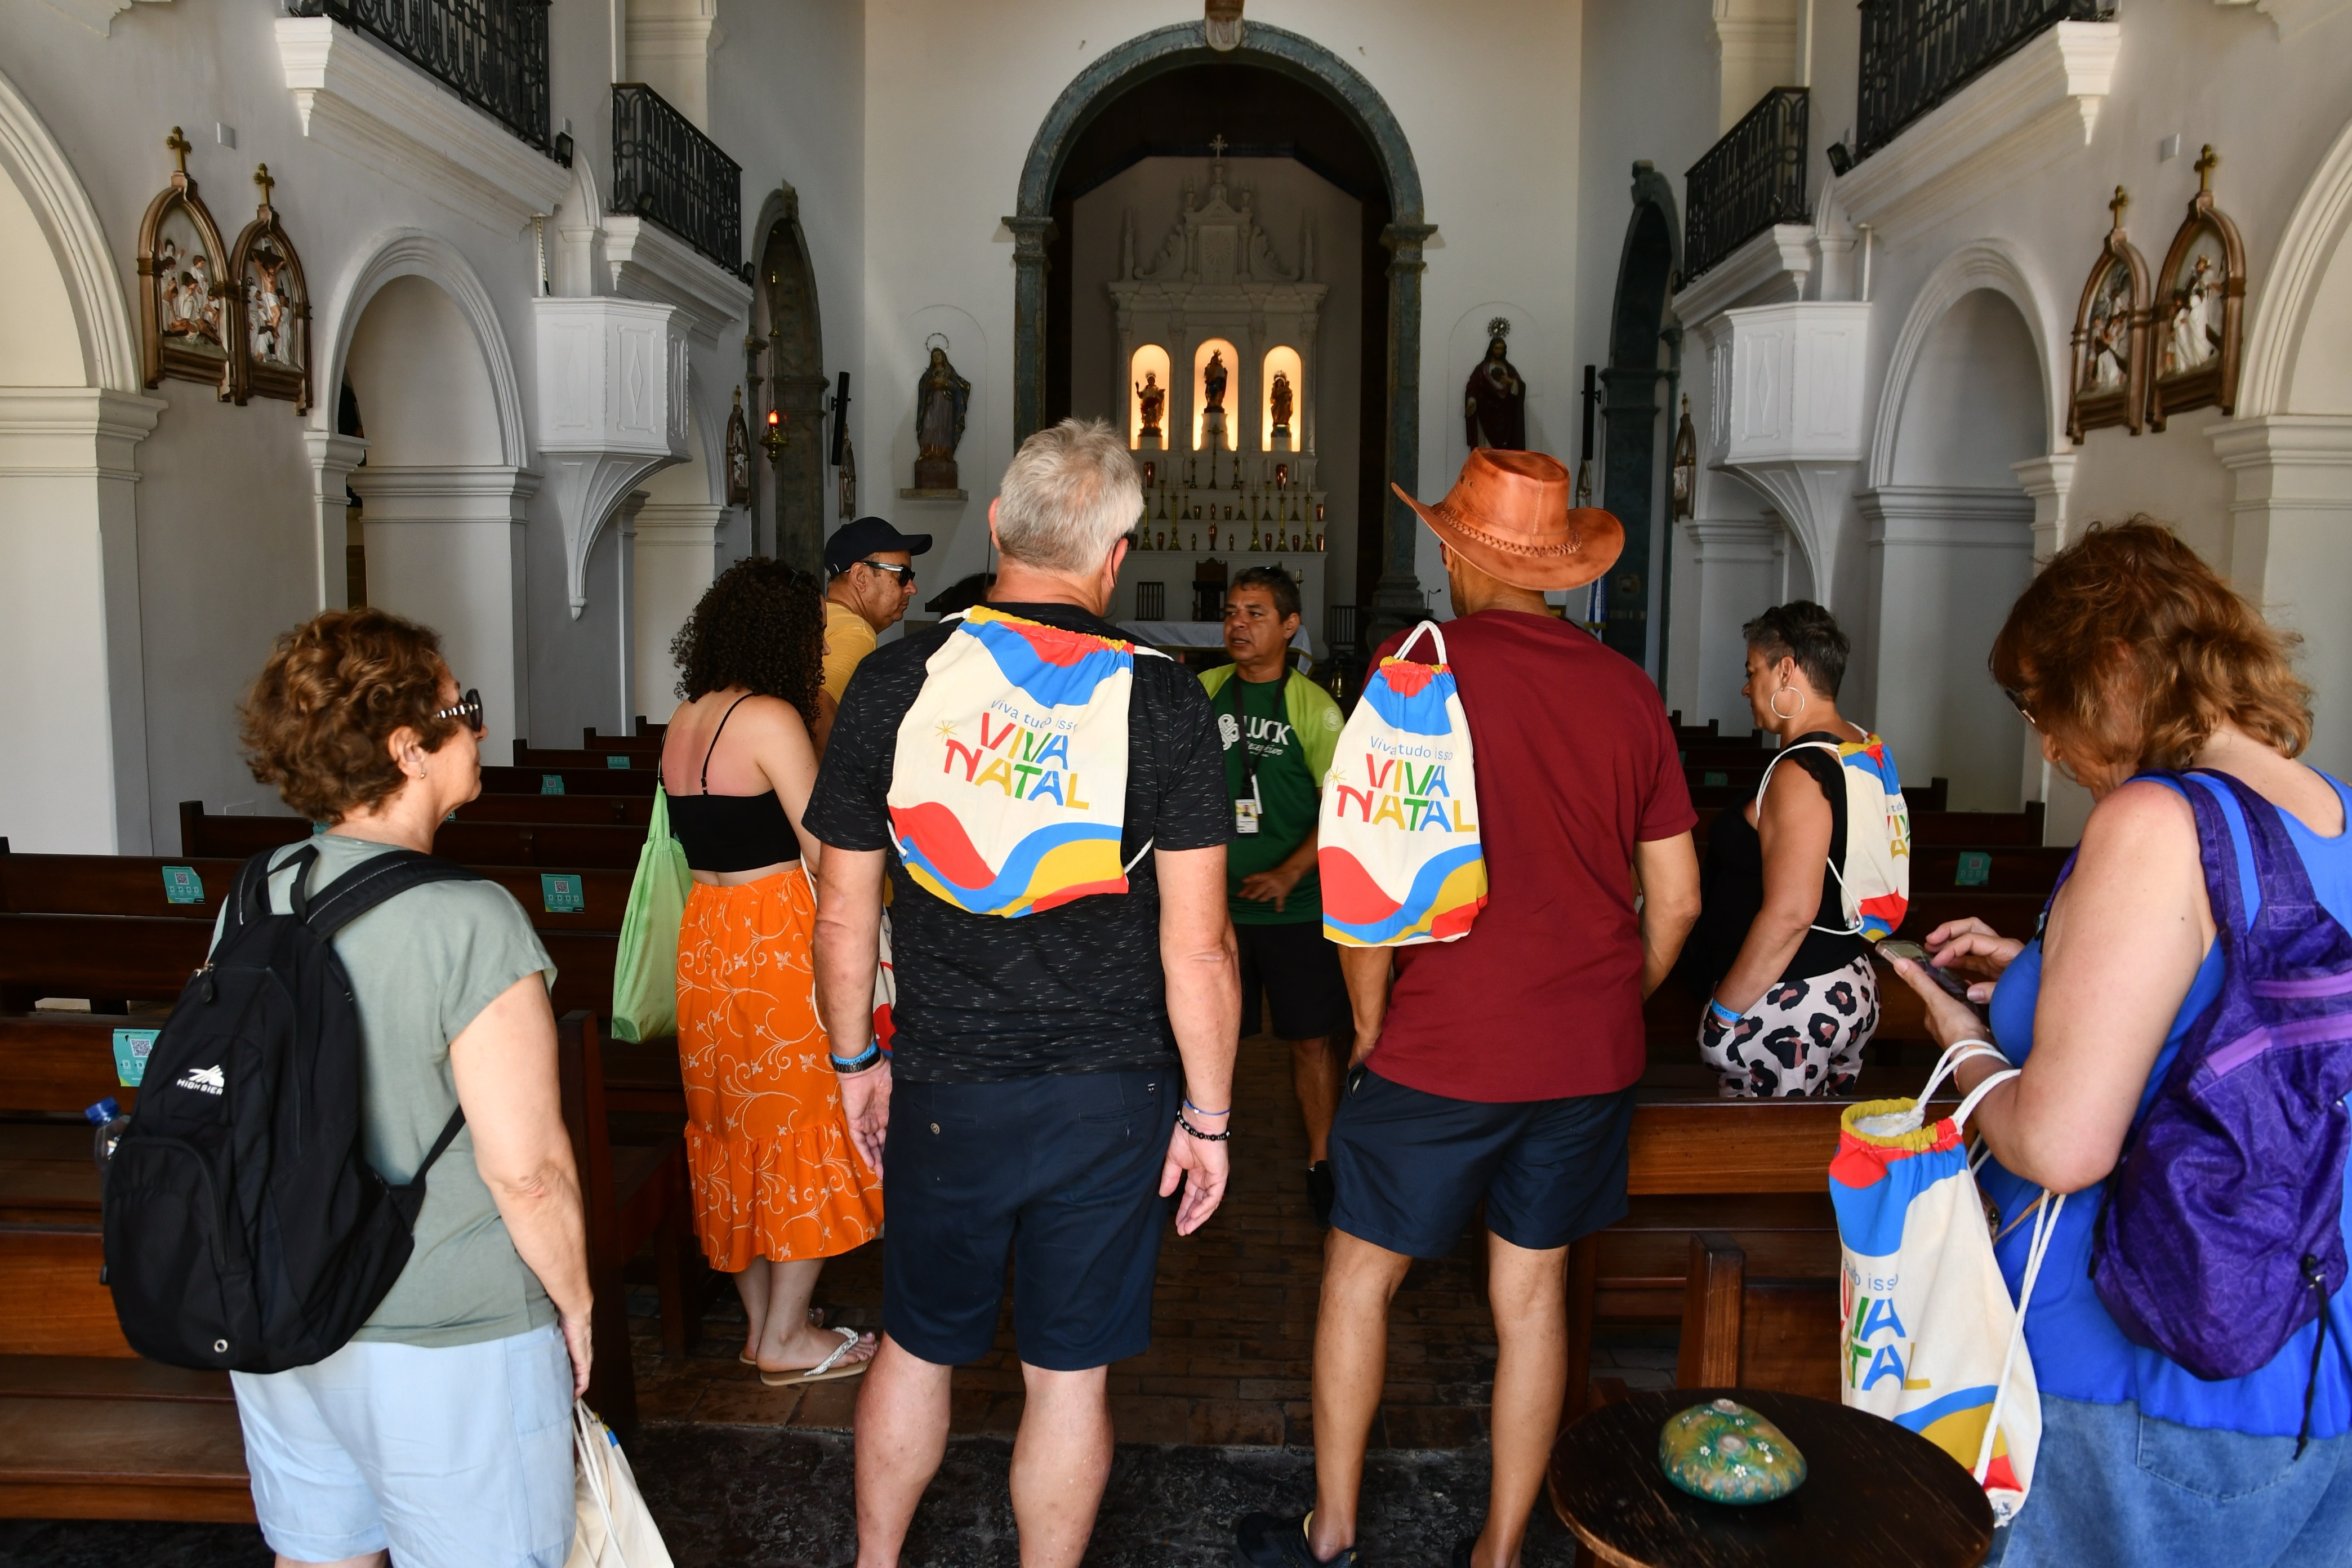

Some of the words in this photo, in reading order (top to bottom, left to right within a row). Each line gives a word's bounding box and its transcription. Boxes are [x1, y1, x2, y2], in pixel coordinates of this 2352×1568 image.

[981, 712, 1068, 770] VIVA
[1370, 736, 1396, 755] Viva
[1398, 743, 1431, 758] tudo
[1435, 747, 1453, 761] isso
[943, 738, 1090, 810] NATAL
[1366, 753, 1450, 798] VIVA
[1337, 784, 1477, 832] NATAL
[177, 1078, 200, 1090] HIGH
